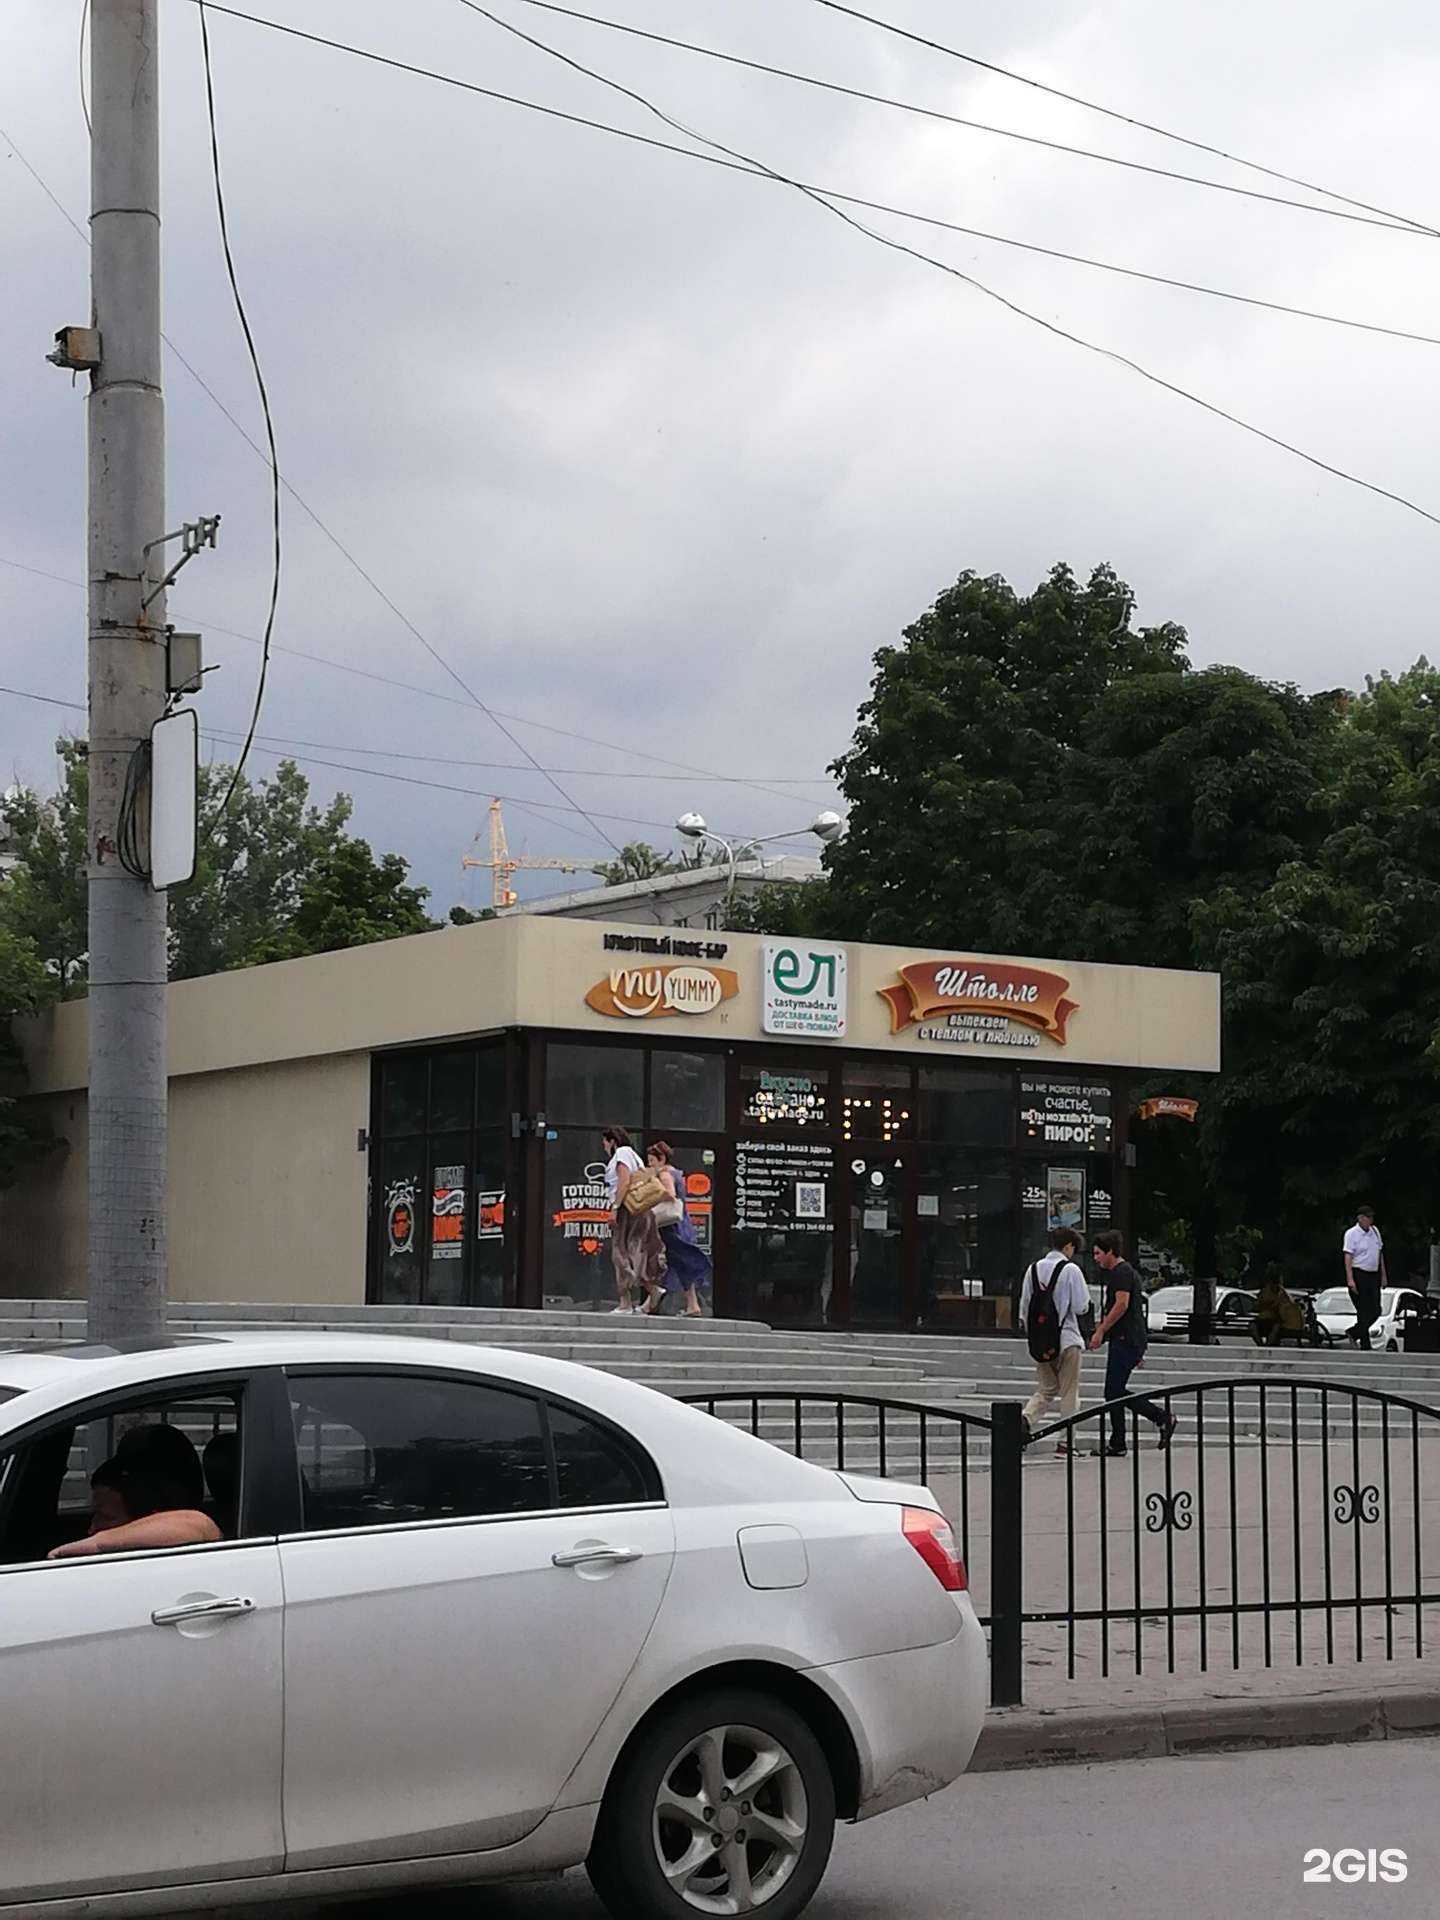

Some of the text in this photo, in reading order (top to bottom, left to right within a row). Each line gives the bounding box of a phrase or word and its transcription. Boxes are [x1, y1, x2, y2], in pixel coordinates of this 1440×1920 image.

[609, 968, 717, 1015] my YUMMY
[935, 966, 1039, 1002] Штолле
[774, 998, 838, 1010] tastymade.ru
[772, 1010, 813, 1020] ДОСТАВКА
[948, 1014, 1009, 1029] выпекаем
[773, 1020, 785, 1028] ОТ
[929, 1028, 974, 1041] теплом
[985, 1031, 1041, 1047] любовью
[1045, 1124, 1092, 1142] ПИРОГ
